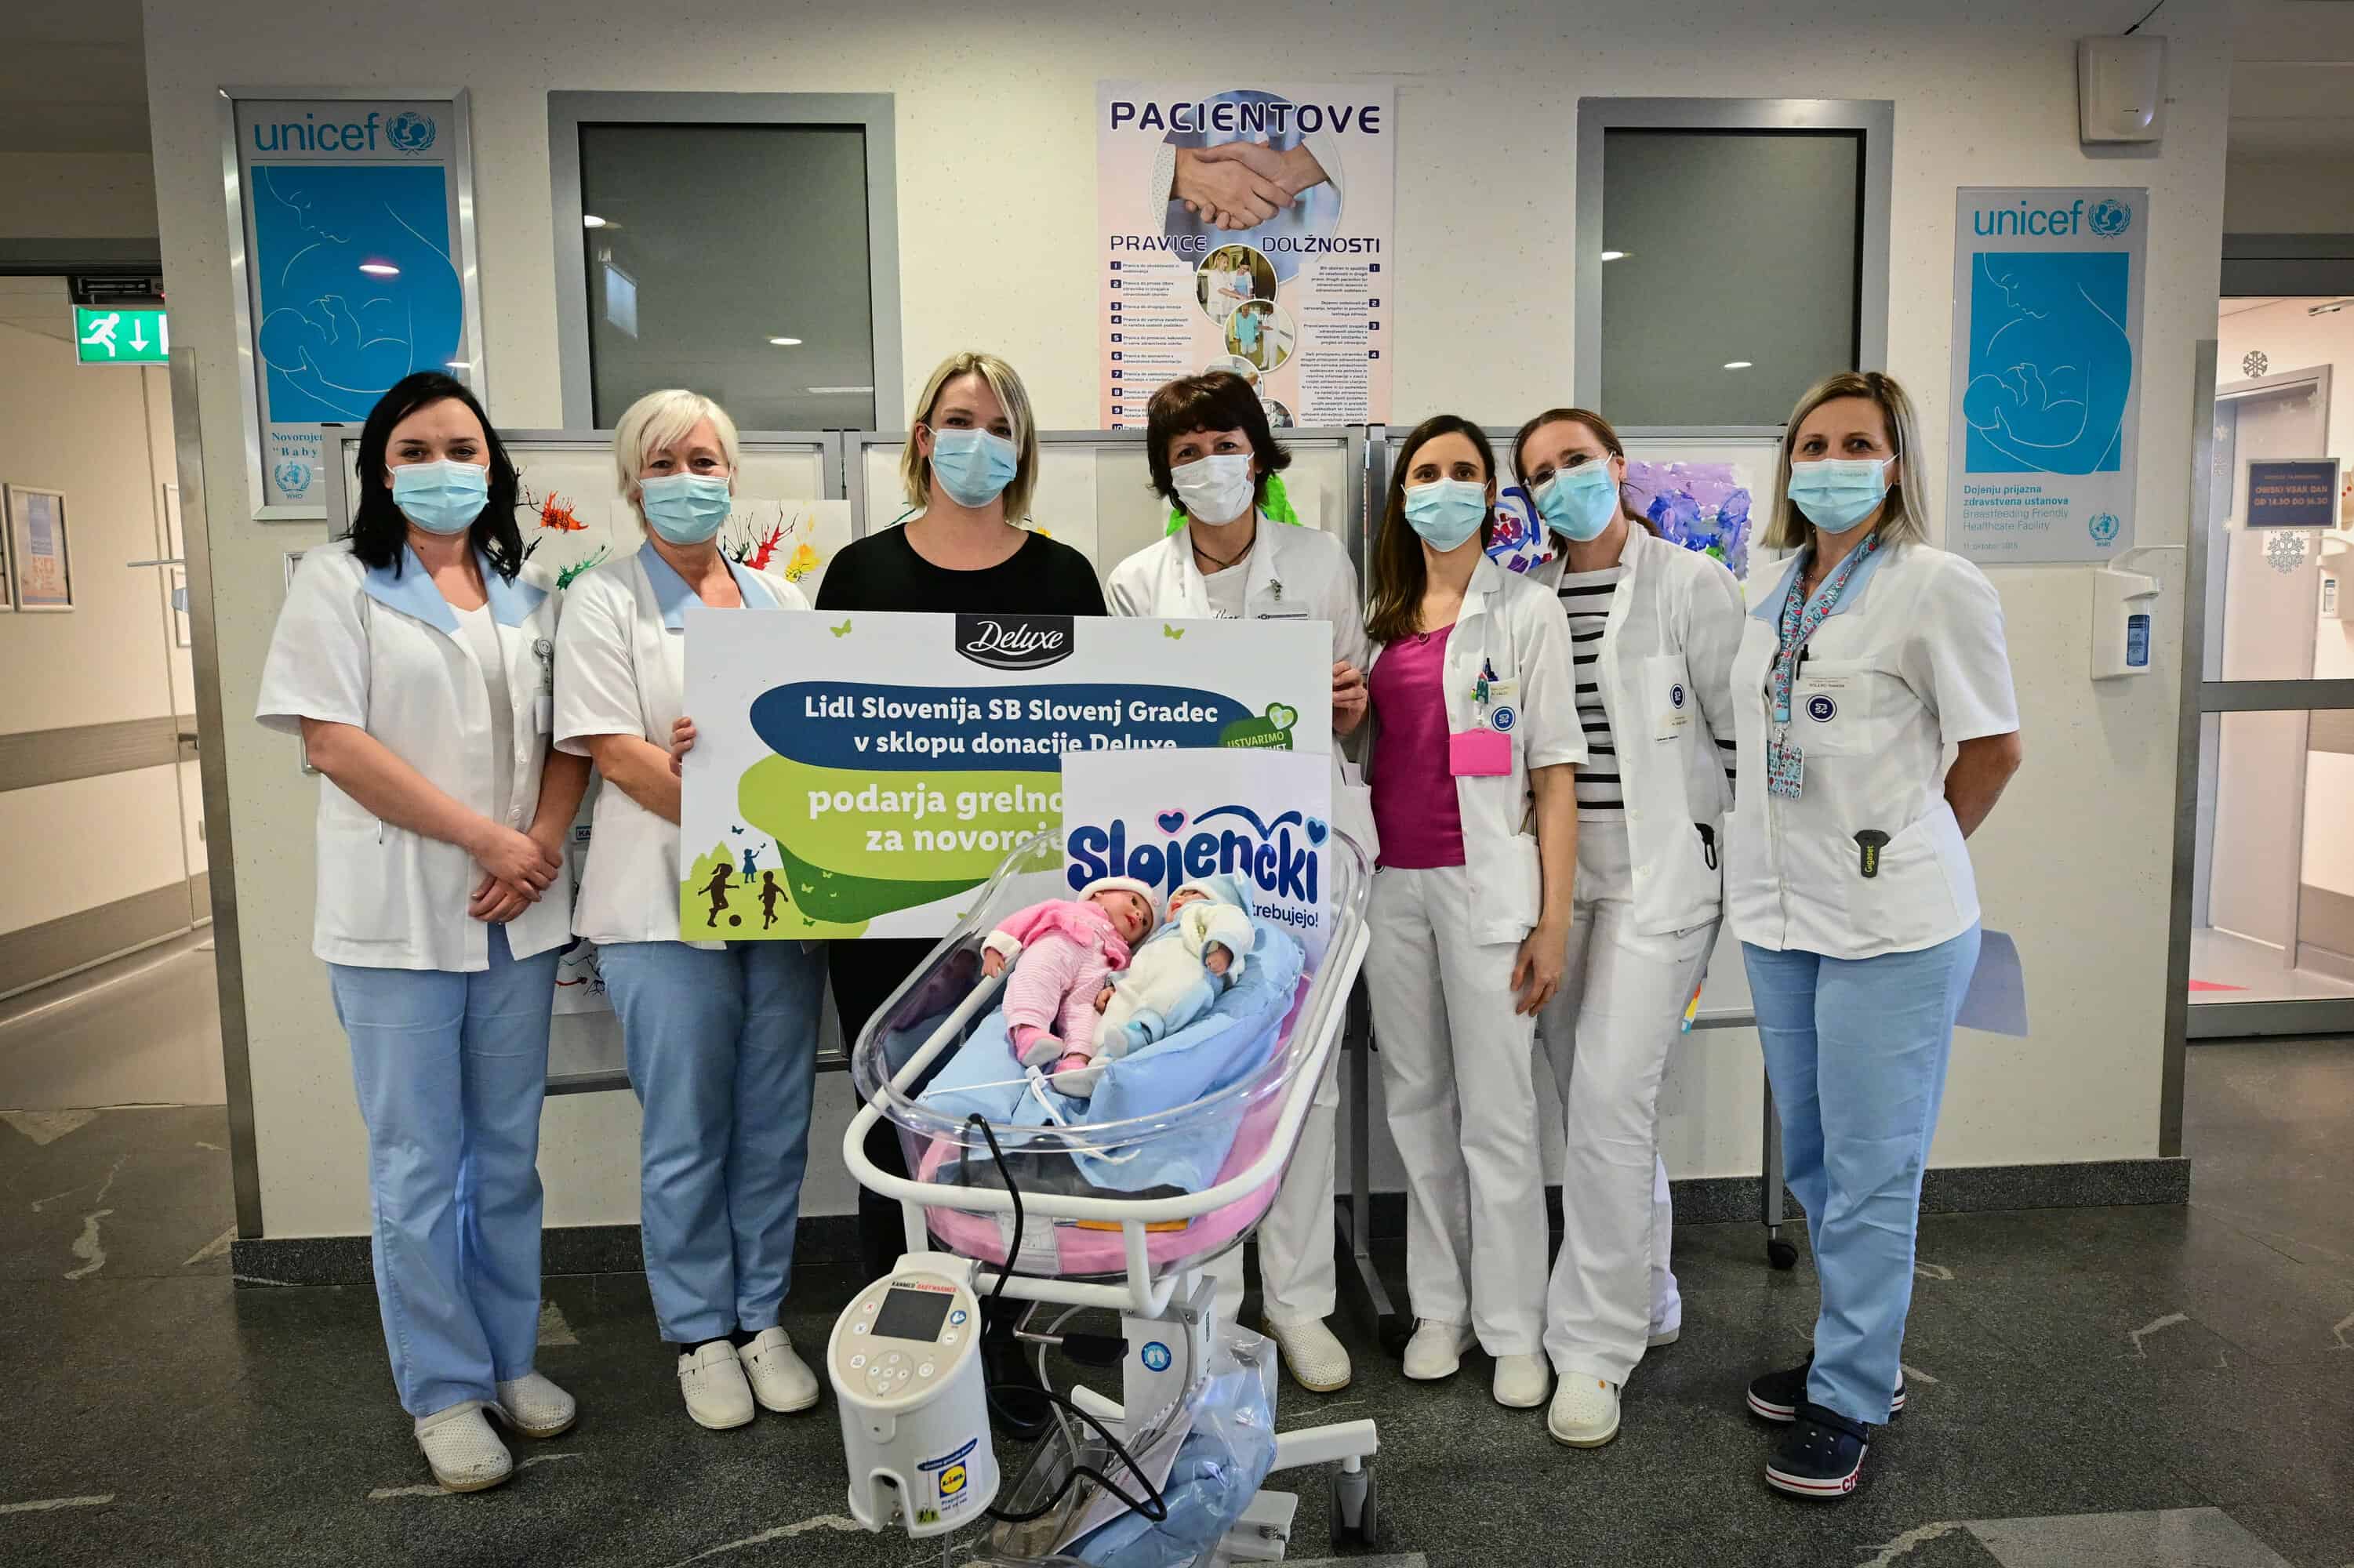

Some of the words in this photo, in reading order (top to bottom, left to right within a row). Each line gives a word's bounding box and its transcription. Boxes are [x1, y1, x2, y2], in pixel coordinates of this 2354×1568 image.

[1110, 101, 1381, 134] PACIENTOVE
[254, 112, 381, 151] unicef
[1974, 200, 2084, 236] unicef
[1110, 235, 1208, 252] PRAVICE
[1262, 234, 1381, 253] DOLŽNOSTI
[1963, 485, 2001, 495] Dojenju
[2003, 485, 2042, 495] prijazna
[1963, 496, 2022, 506] zdravstvena
[2025, 497, 2069, 506] ustanova
[1963, 508, 2029, 519] Breastfeeding
[2032, 507, 2069, 518] Friendly
[1963, 521, 2015, 530] Healthcare
[2017, 520, 2051, 531] Facility
[966, 621, 1064, 656] Deluxe
[805, 695, 855, 718] Lidl
[861, 697, 982, 725] Slovenija
[988, 699, 1022, 720] SB
[1029, 699, 1122, 726] Slovenj
[1129, 701, 1219, 723] Gradec
[854, 735, 870, 753] v
[876, 731, 965, 758] sklopu
[972, 731, 1083, 758] donacije
[1089, 733, 1177, 750] Deluxe
[1226, 731, 1284, 748] USTVARIMO
[808, 782, 947, 820] podarja
[866, 829, 903, 851] za
[1865, 844, 1875, 873] Gigaset
